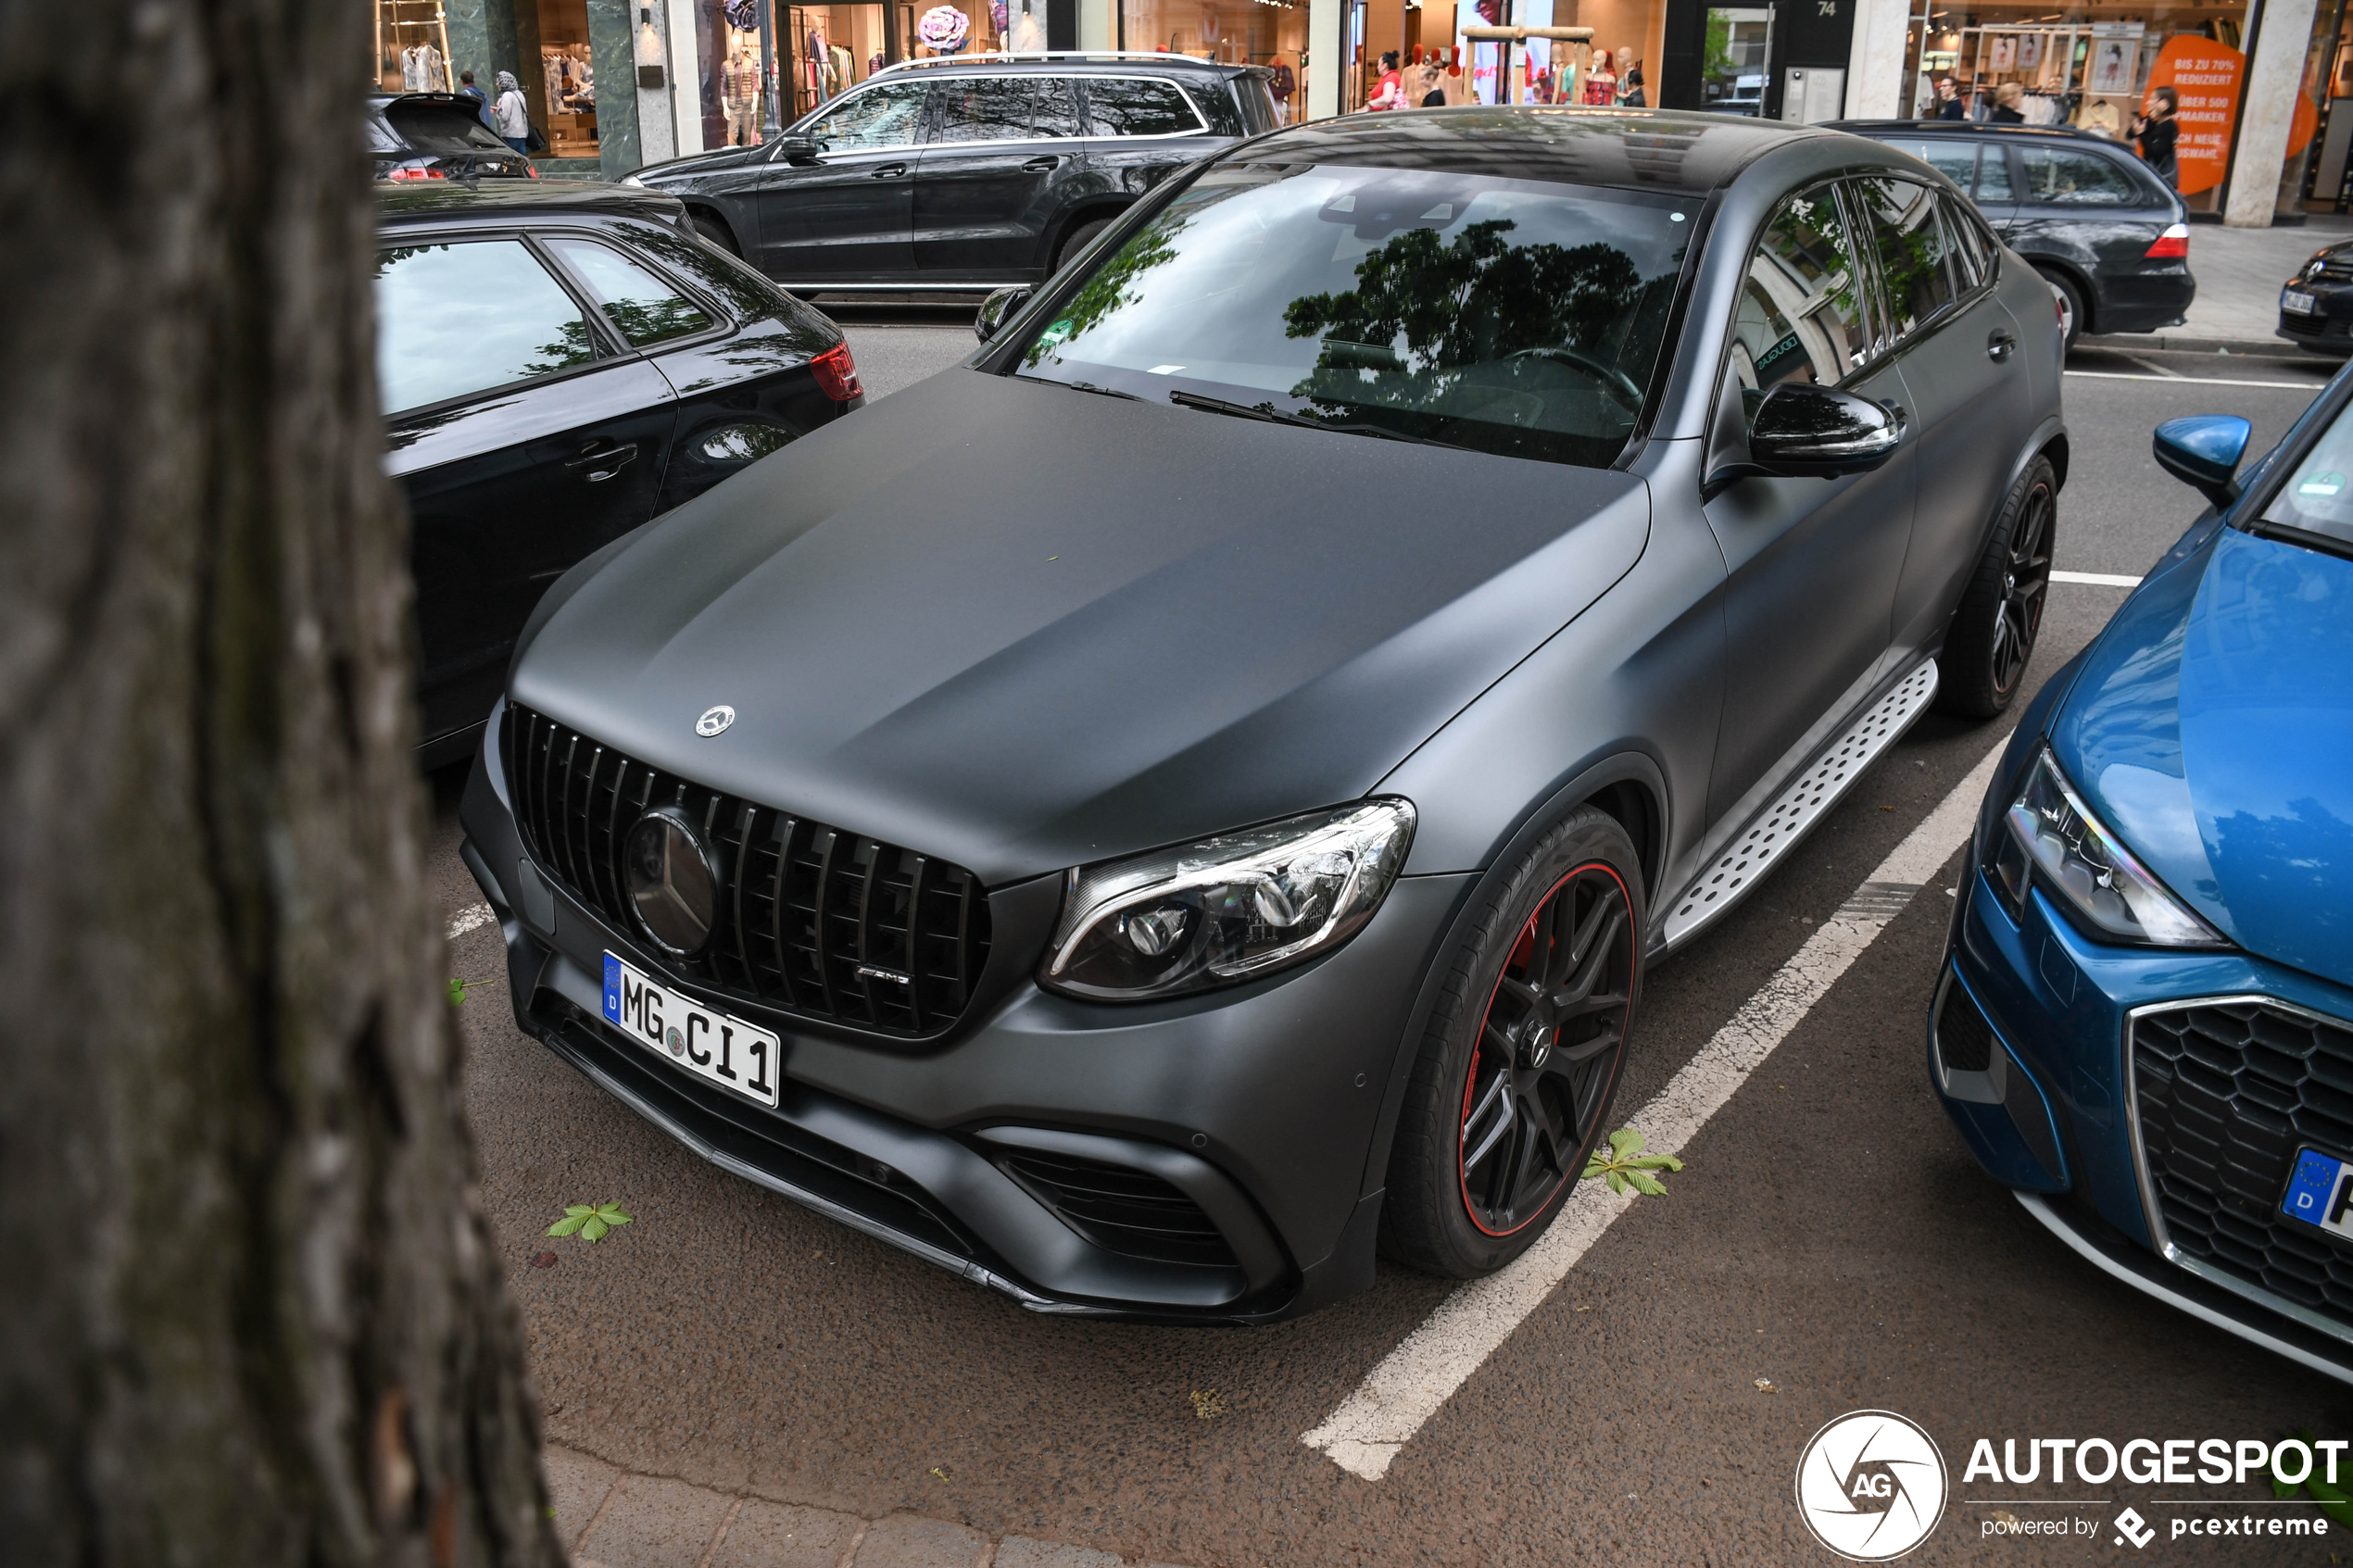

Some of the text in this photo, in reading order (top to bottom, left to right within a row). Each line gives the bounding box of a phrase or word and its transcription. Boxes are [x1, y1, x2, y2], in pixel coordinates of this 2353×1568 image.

[1818, 1, 1836, 17] 74
[2174, 58, 2235, 71] BIS ZU 70%
[2174, 73, 2233, 86] REDUZIERT
[2178, 94, 2229, 108] ÜBER 500
[2175, 110, 2226, 122] PMARKEN
[2194, 134, 2222, 145] NEUE
[2175, 147, 2219, 159] USWAHL
[609, 995, 617, 1010] D
[623, 972, 664, 1046] MG
[2297, 1192, 2313, 1209] D
